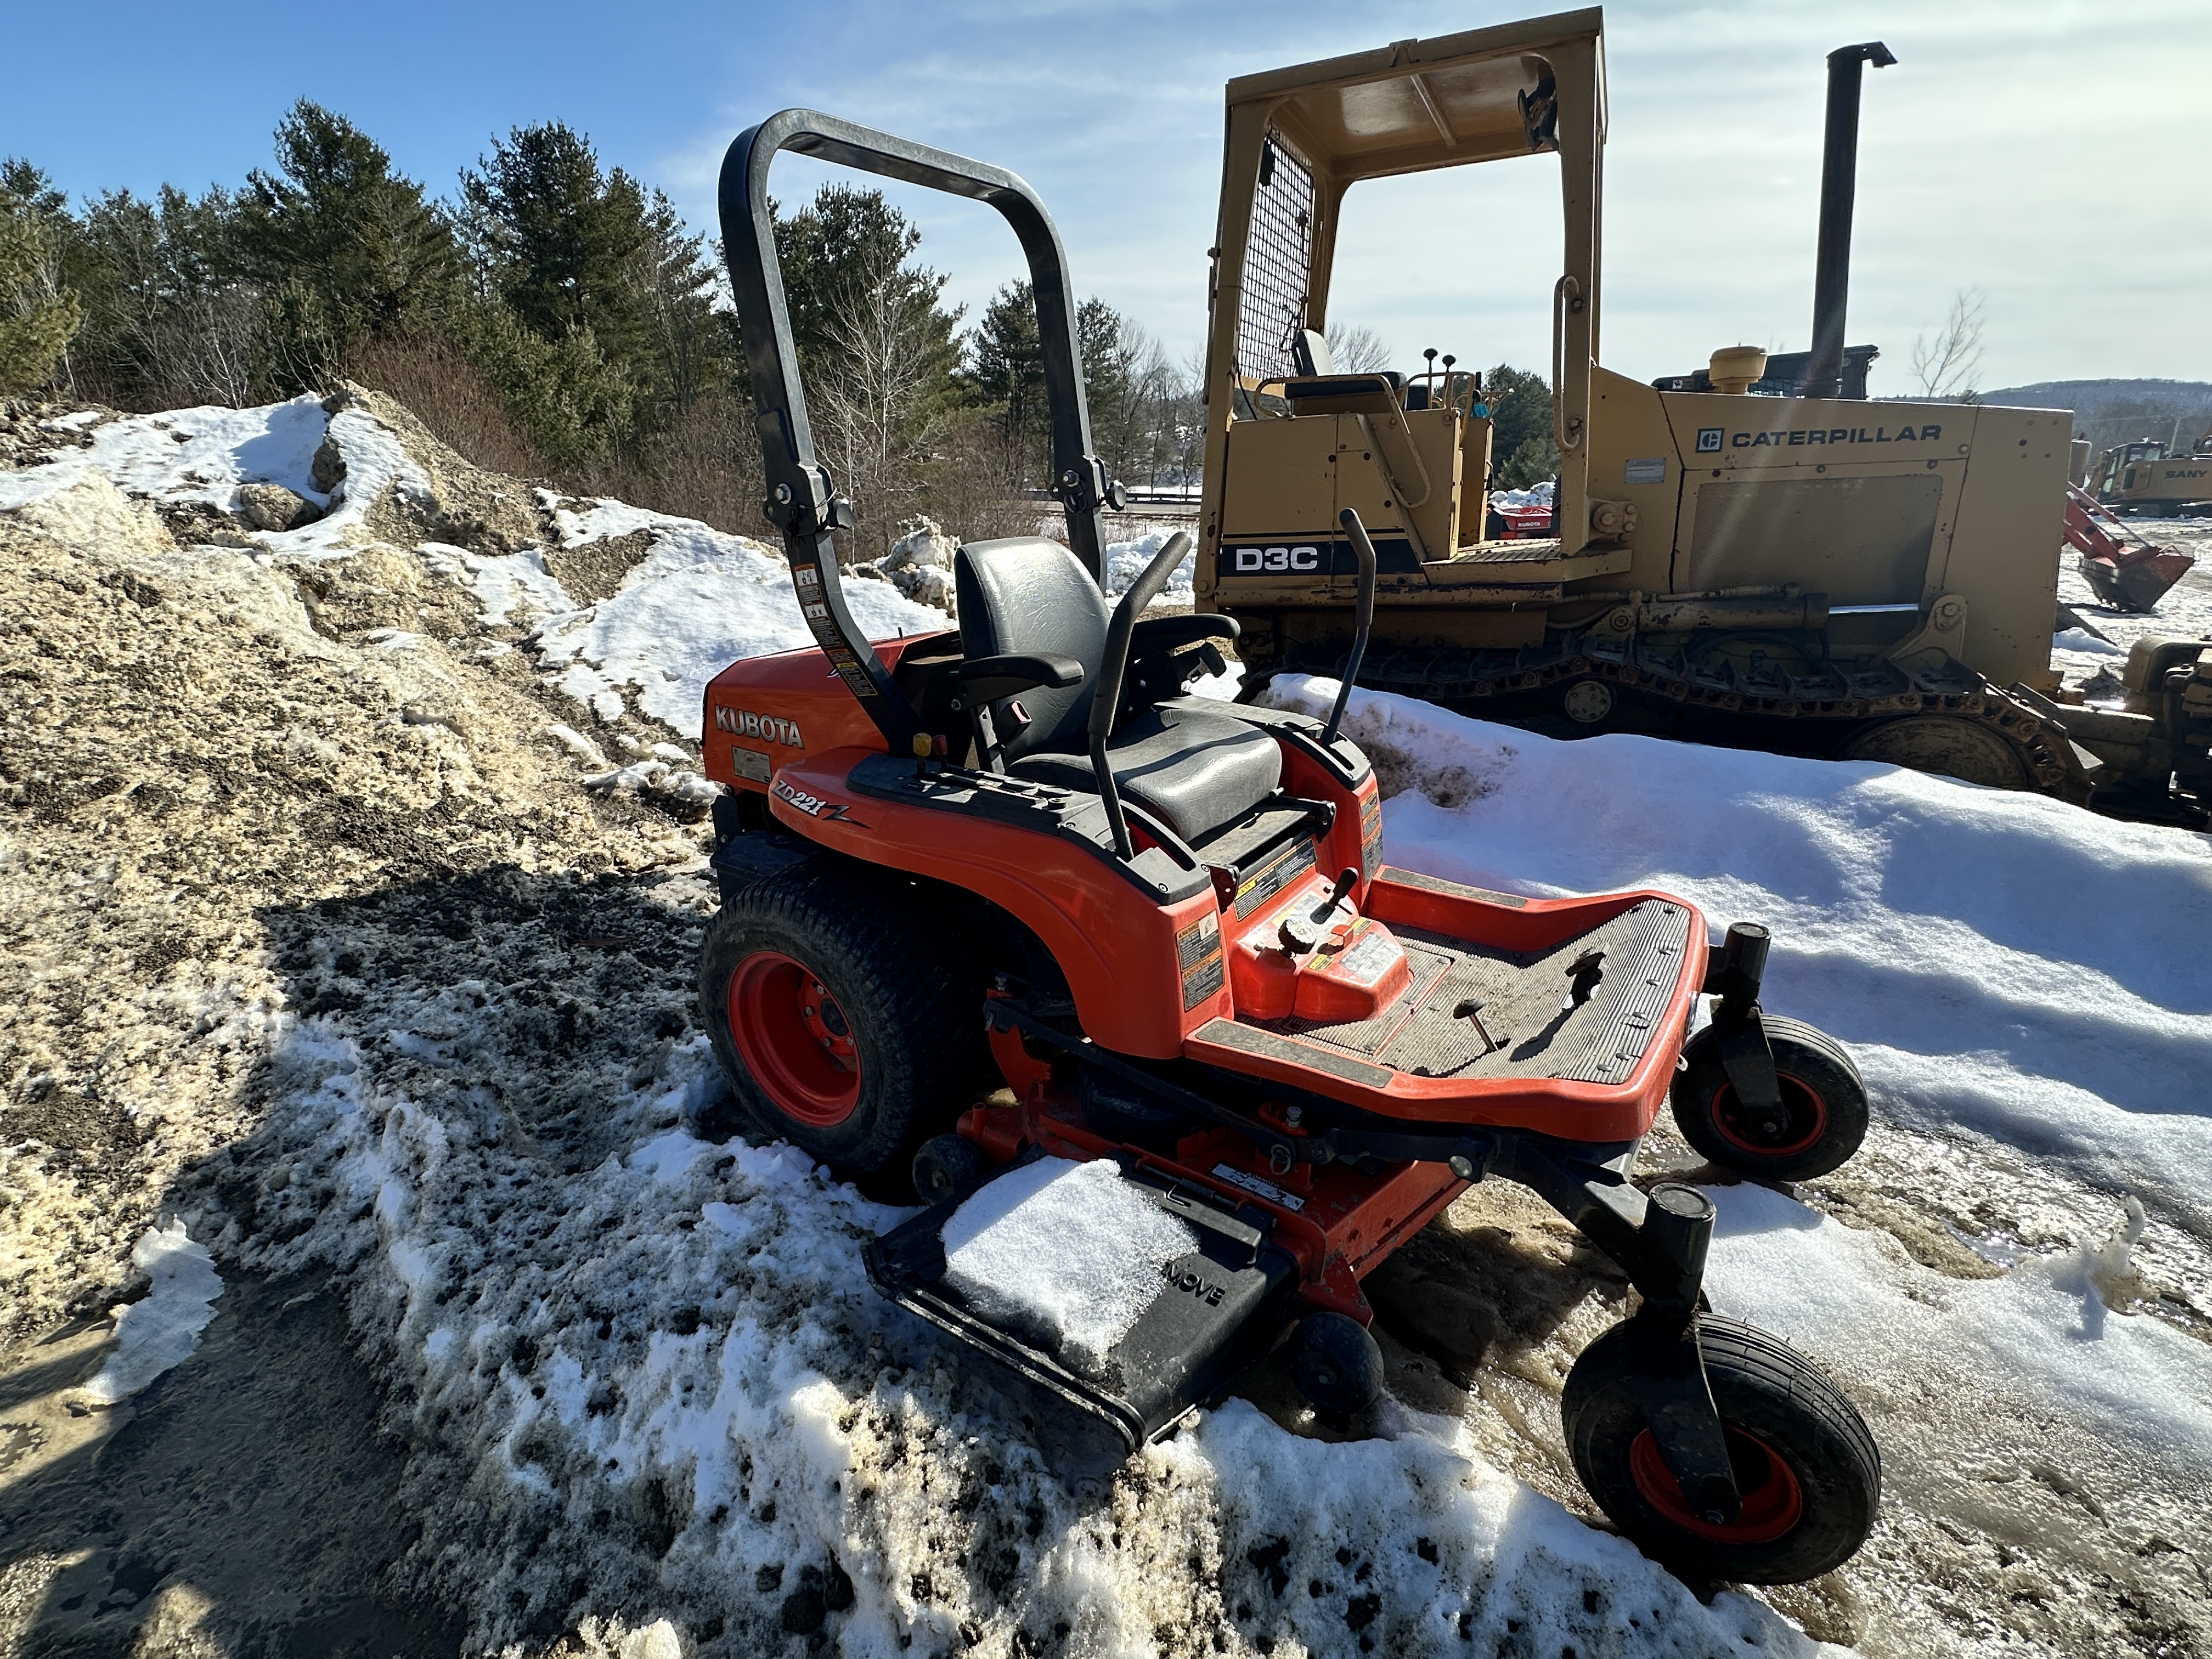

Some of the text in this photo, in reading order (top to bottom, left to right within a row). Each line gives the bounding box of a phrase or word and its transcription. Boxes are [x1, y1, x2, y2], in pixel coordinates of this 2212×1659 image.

[1731, 425, 1942, 448] CATERPILLAR
[2164, 470, 2208, 479] SANY
[1236, 547, 1318, 571] D3C
[715, 704, 805, 750] KUBOTA
[772, 779, 828, 816] ZD221
[1161, 1261, 1226, 1307] MOVE
